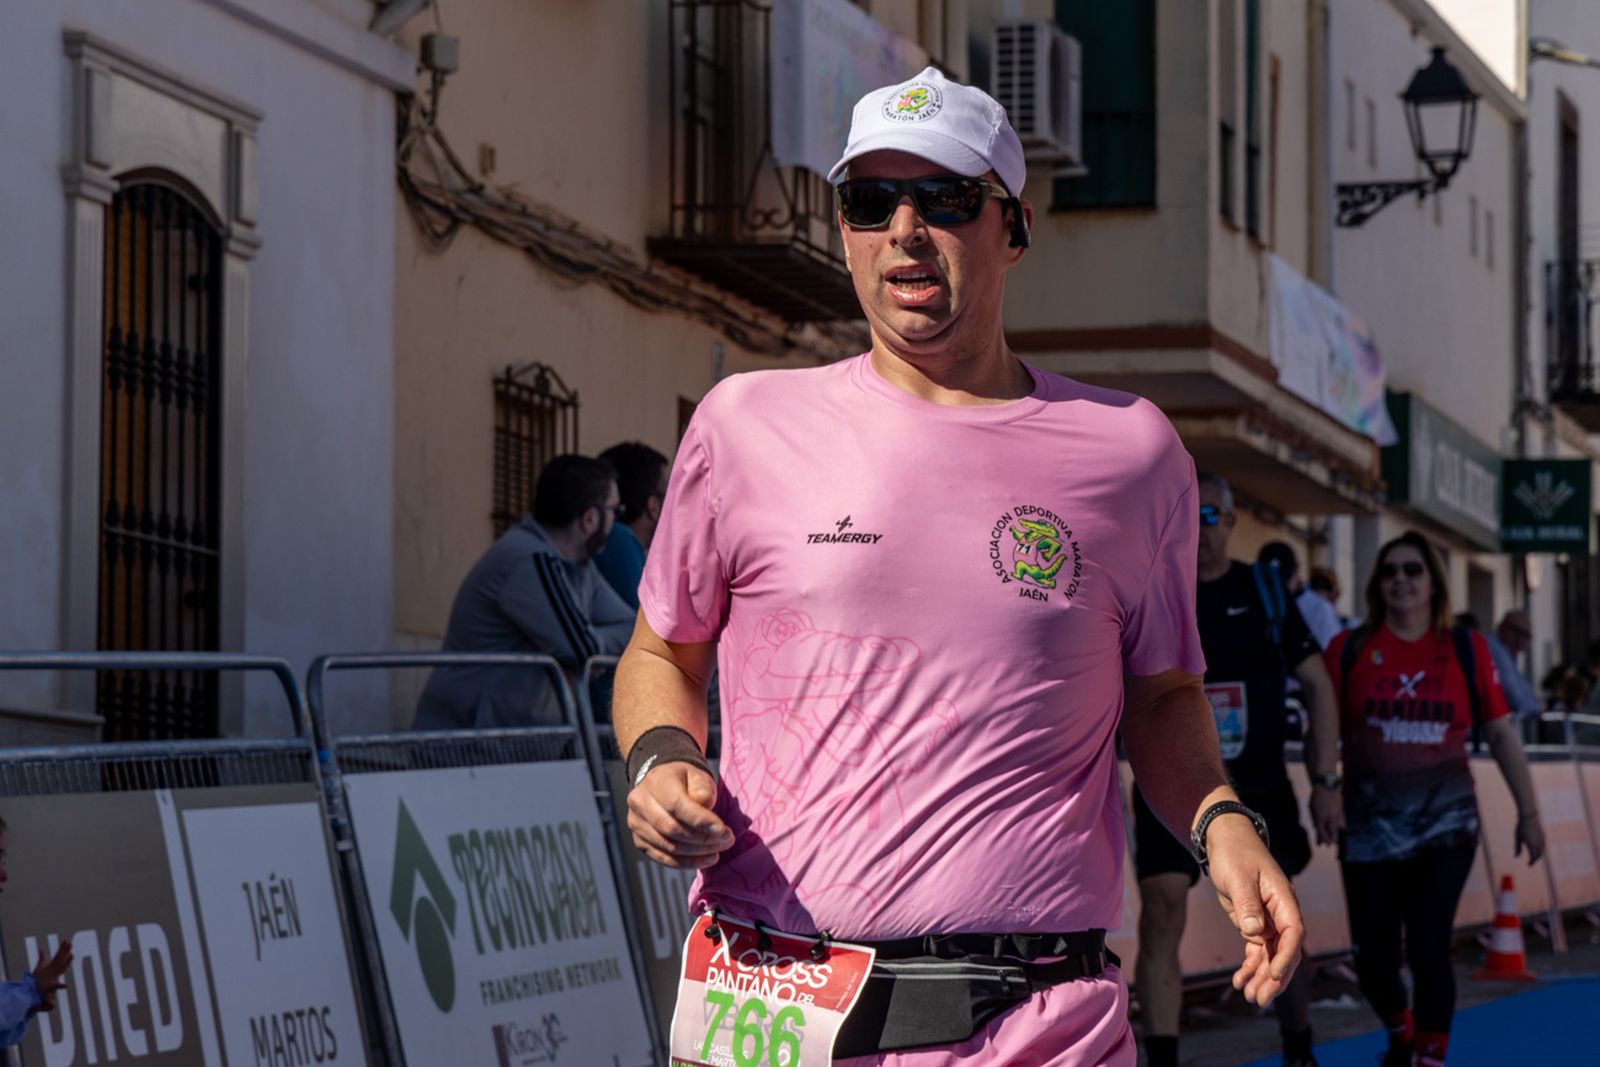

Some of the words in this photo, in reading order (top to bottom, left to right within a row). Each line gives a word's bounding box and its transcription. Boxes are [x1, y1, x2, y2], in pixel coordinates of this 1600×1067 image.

[806, 533, 883, 545] TEAMERGY
[989, 512, 1013, 584] ASOCIACION
[1013, 505, 1073, 539] DEPORTIVA
[1063, 541, 1082, 600] MARATON
[1019, 588, 1049, 602] JAÉN
[242, 872, 303, 962] JAÉN
[479, 967, 564, 1006] FRANCHISING
[565, 956, 624, 991] NETWORK
[704, 966, 796, 1007] PANTANO
[710, 932, 740, 967] X
[736, 947, 833, 989] CROSS
[24, 922, 184, 1067] UNED
[250, 1005, 338, 1067] MARTOS
[699, 988, 807, 1067] 766
